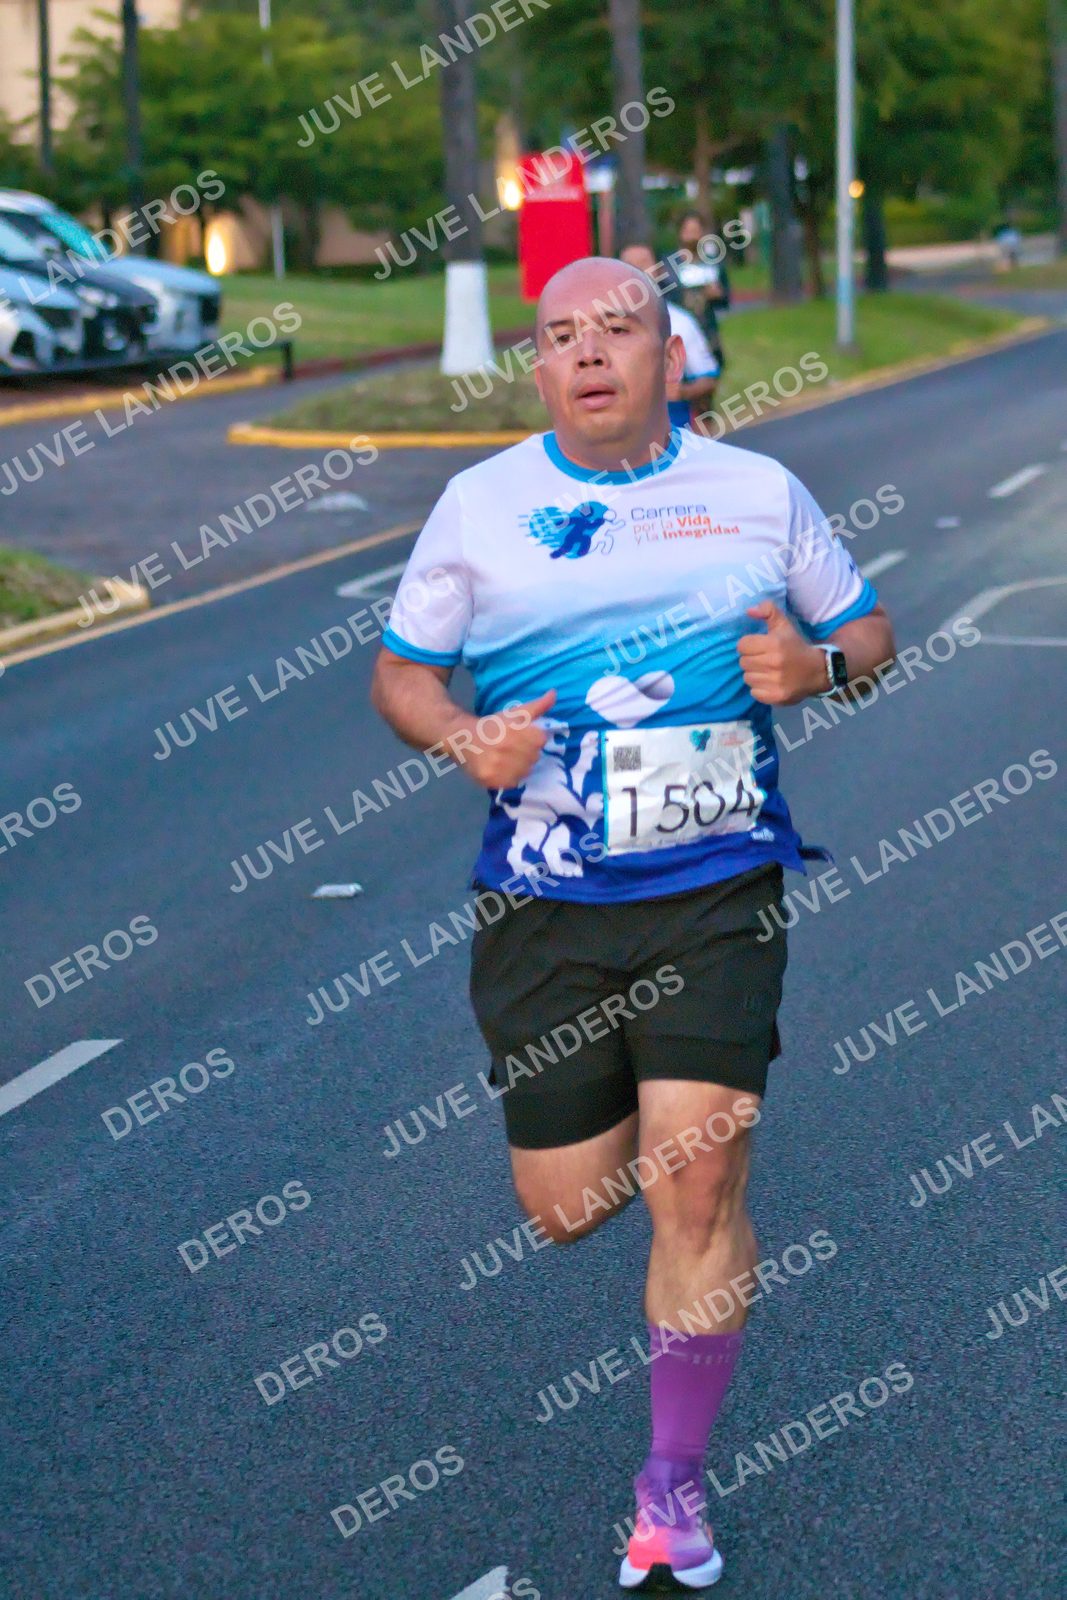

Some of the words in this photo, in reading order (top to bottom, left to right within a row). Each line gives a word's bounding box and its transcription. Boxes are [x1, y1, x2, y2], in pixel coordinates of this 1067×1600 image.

[631, 504, 707, 521] Carrera
[633, 520, 654, 535] por
[661, 518, 673, 530] la
[676, 513, 711, 528] Vida
[662, 525, 741, 540] Integridad
[622, 776, 757, 837] 1504
